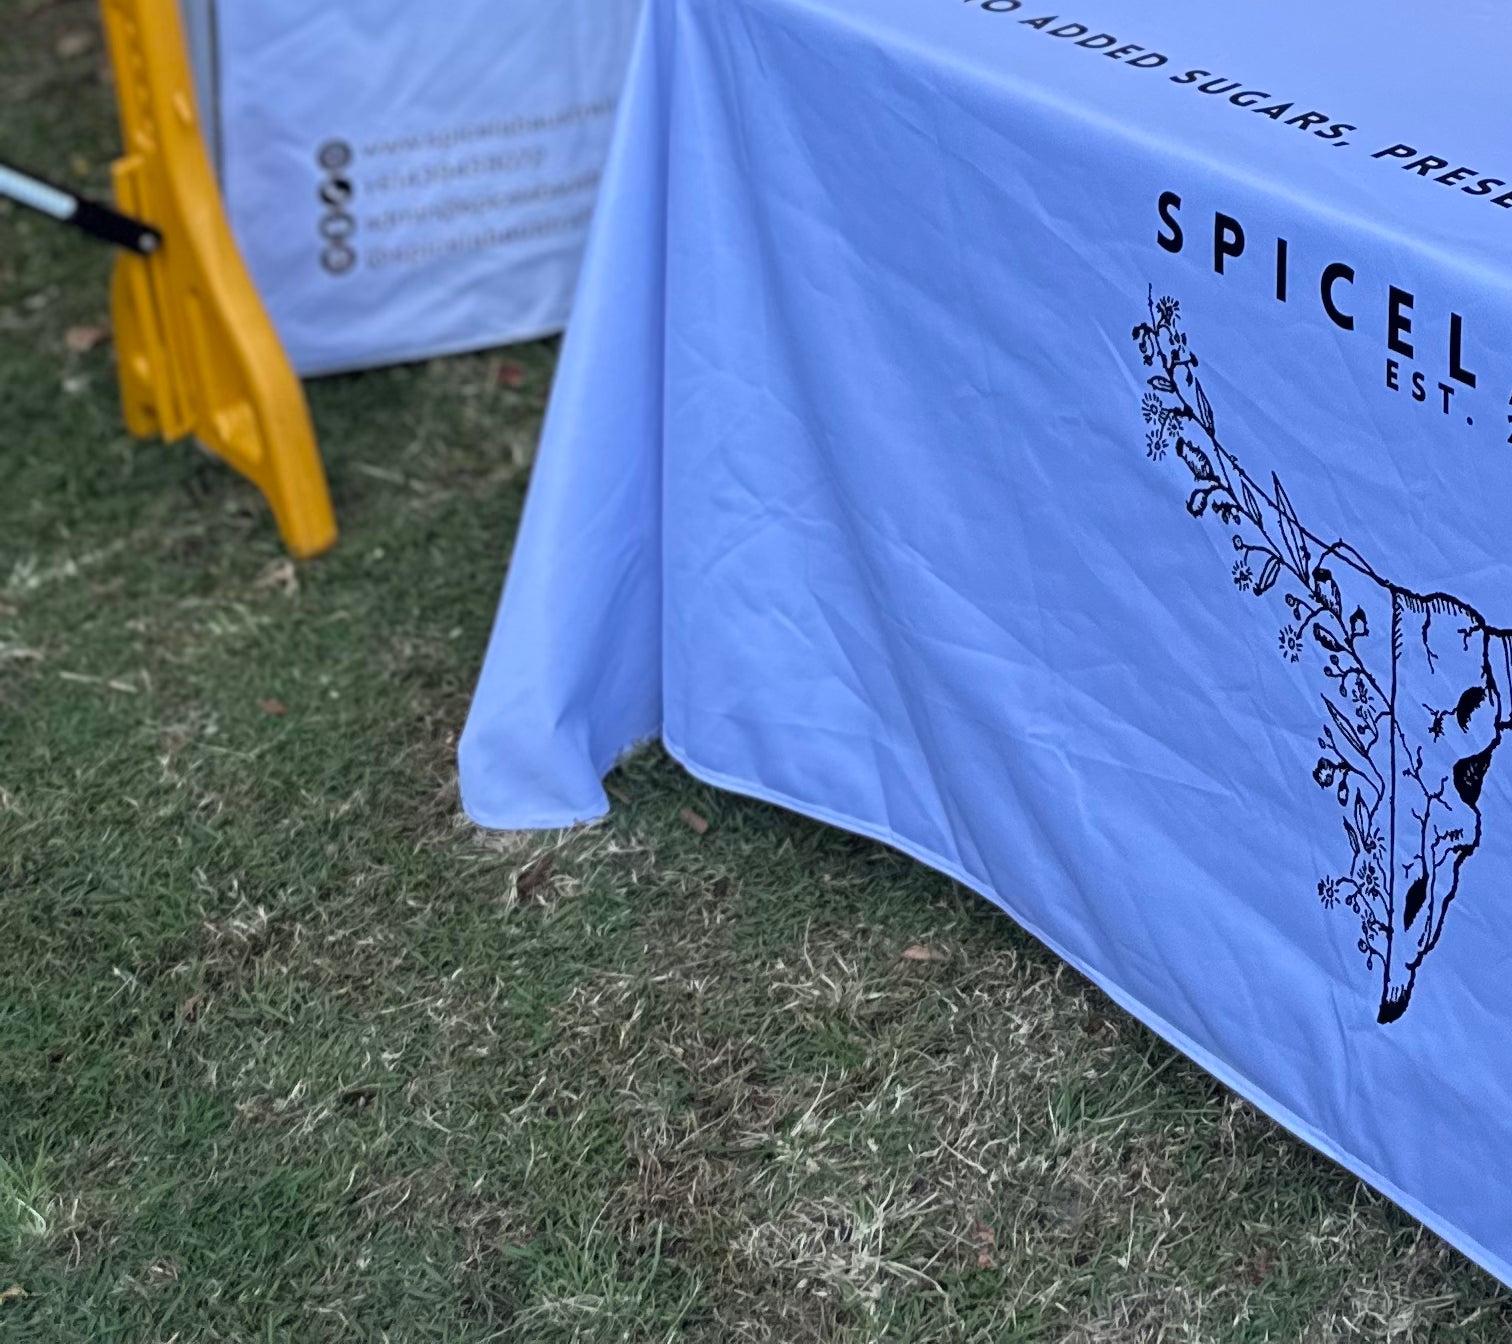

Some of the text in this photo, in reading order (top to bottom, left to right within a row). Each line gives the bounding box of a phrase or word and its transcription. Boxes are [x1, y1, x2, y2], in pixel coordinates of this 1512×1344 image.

[1019, 15, 1169, 68] ADDED
[1170, 69, 1357, 146] SUGARS,
[1386, 358, 1474, 426] EST.
